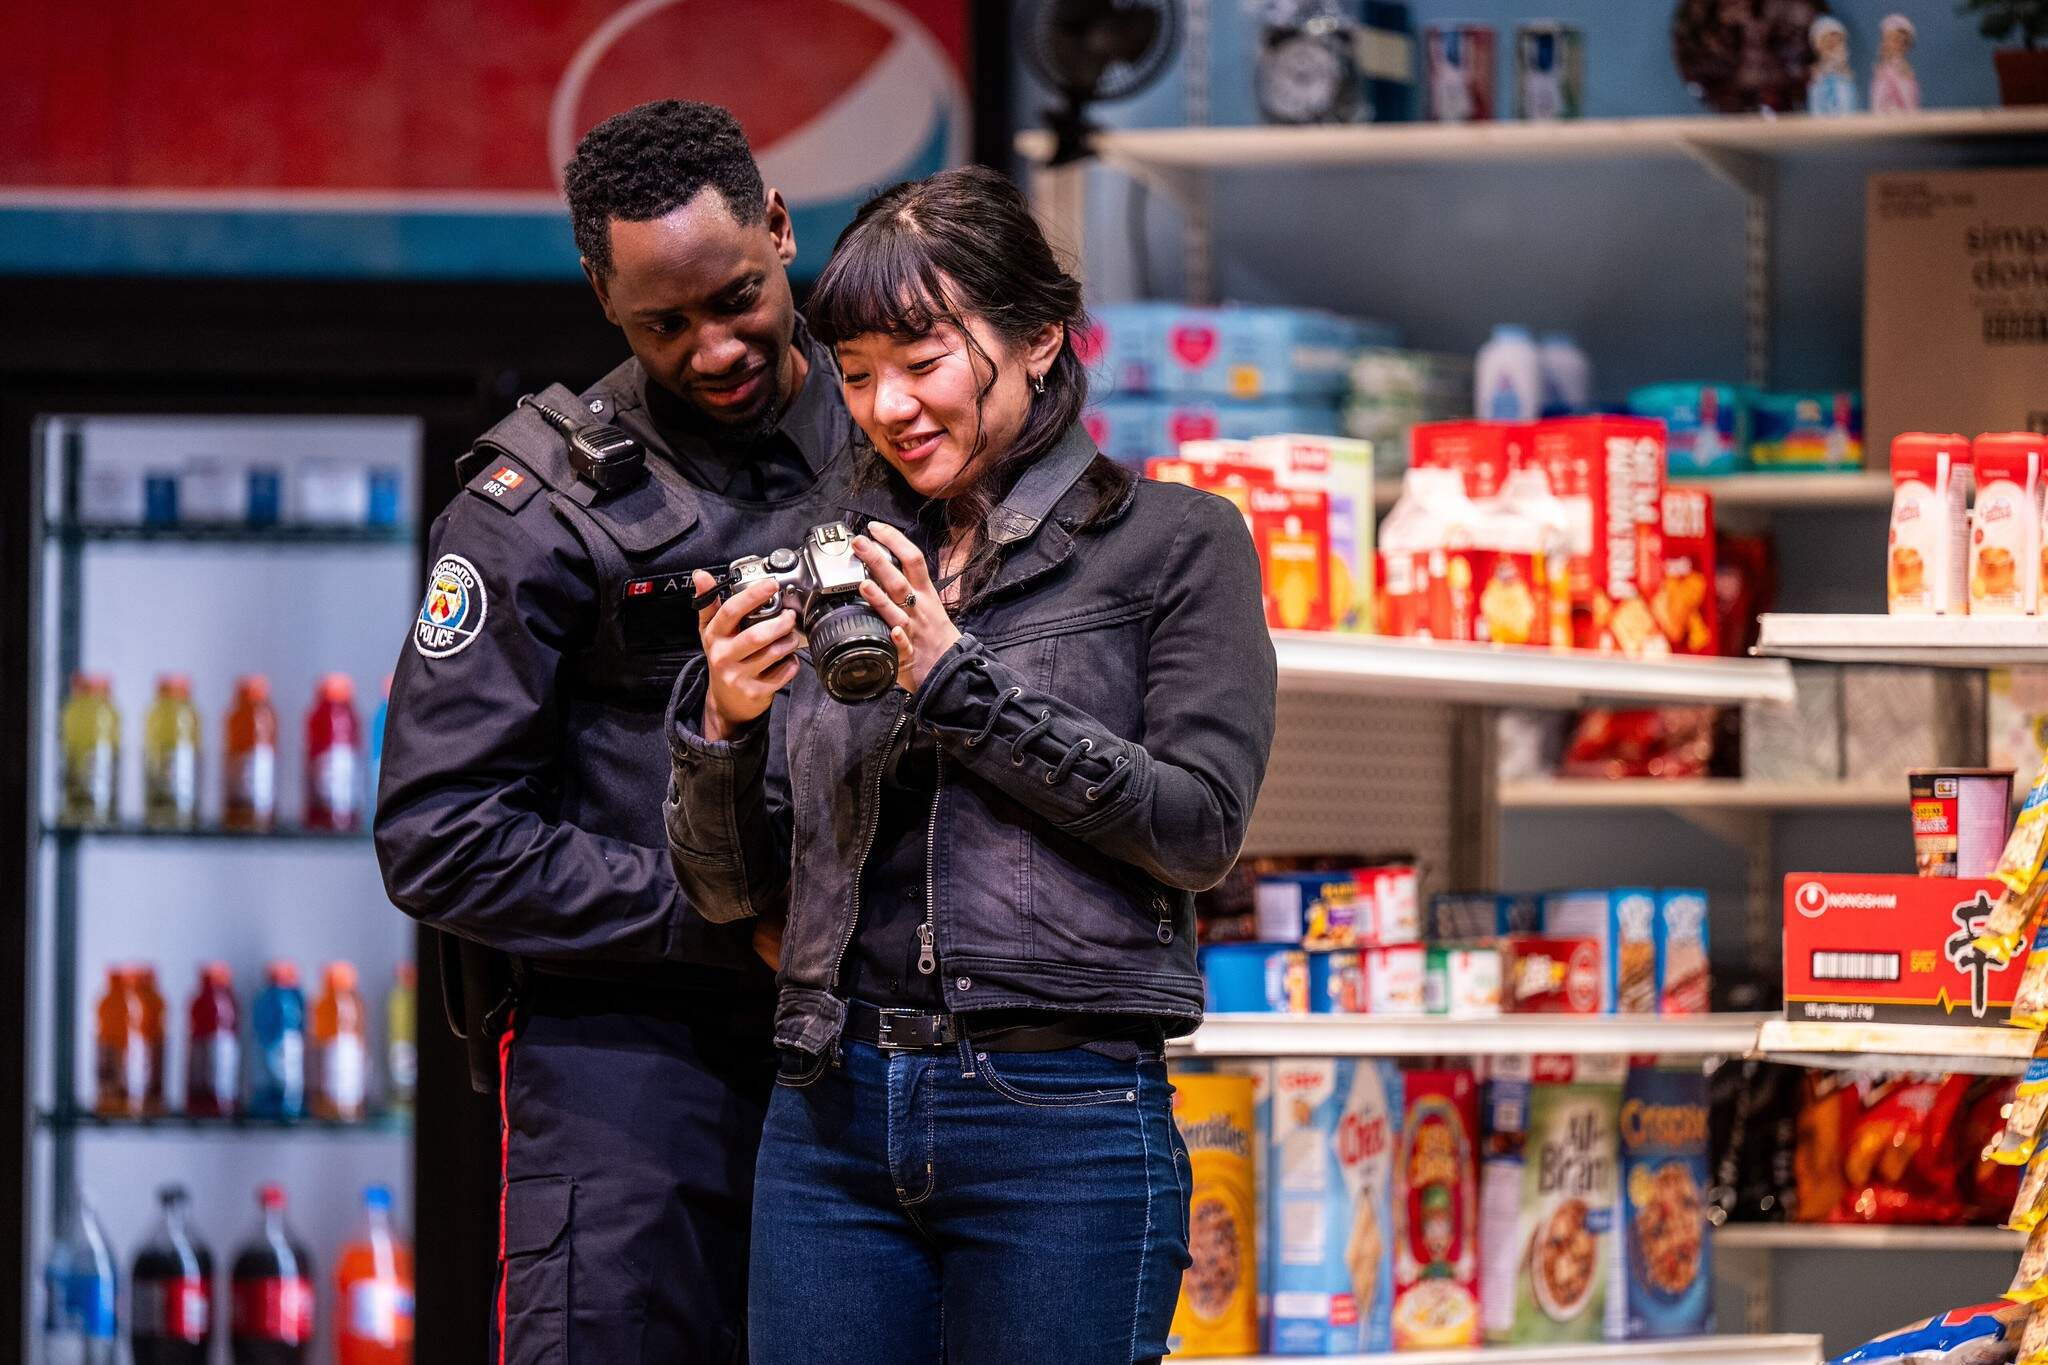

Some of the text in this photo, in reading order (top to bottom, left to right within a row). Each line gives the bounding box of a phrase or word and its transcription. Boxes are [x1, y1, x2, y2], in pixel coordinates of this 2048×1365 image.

[483, 481, 507, 497] 065
[831, 584, 858, 593] Canon
[419, 623, 456, 648] POLICE
[1828, 893, 1897, 909] NONGSHIM
[1538, 1140, 1611, 1194] Bran
